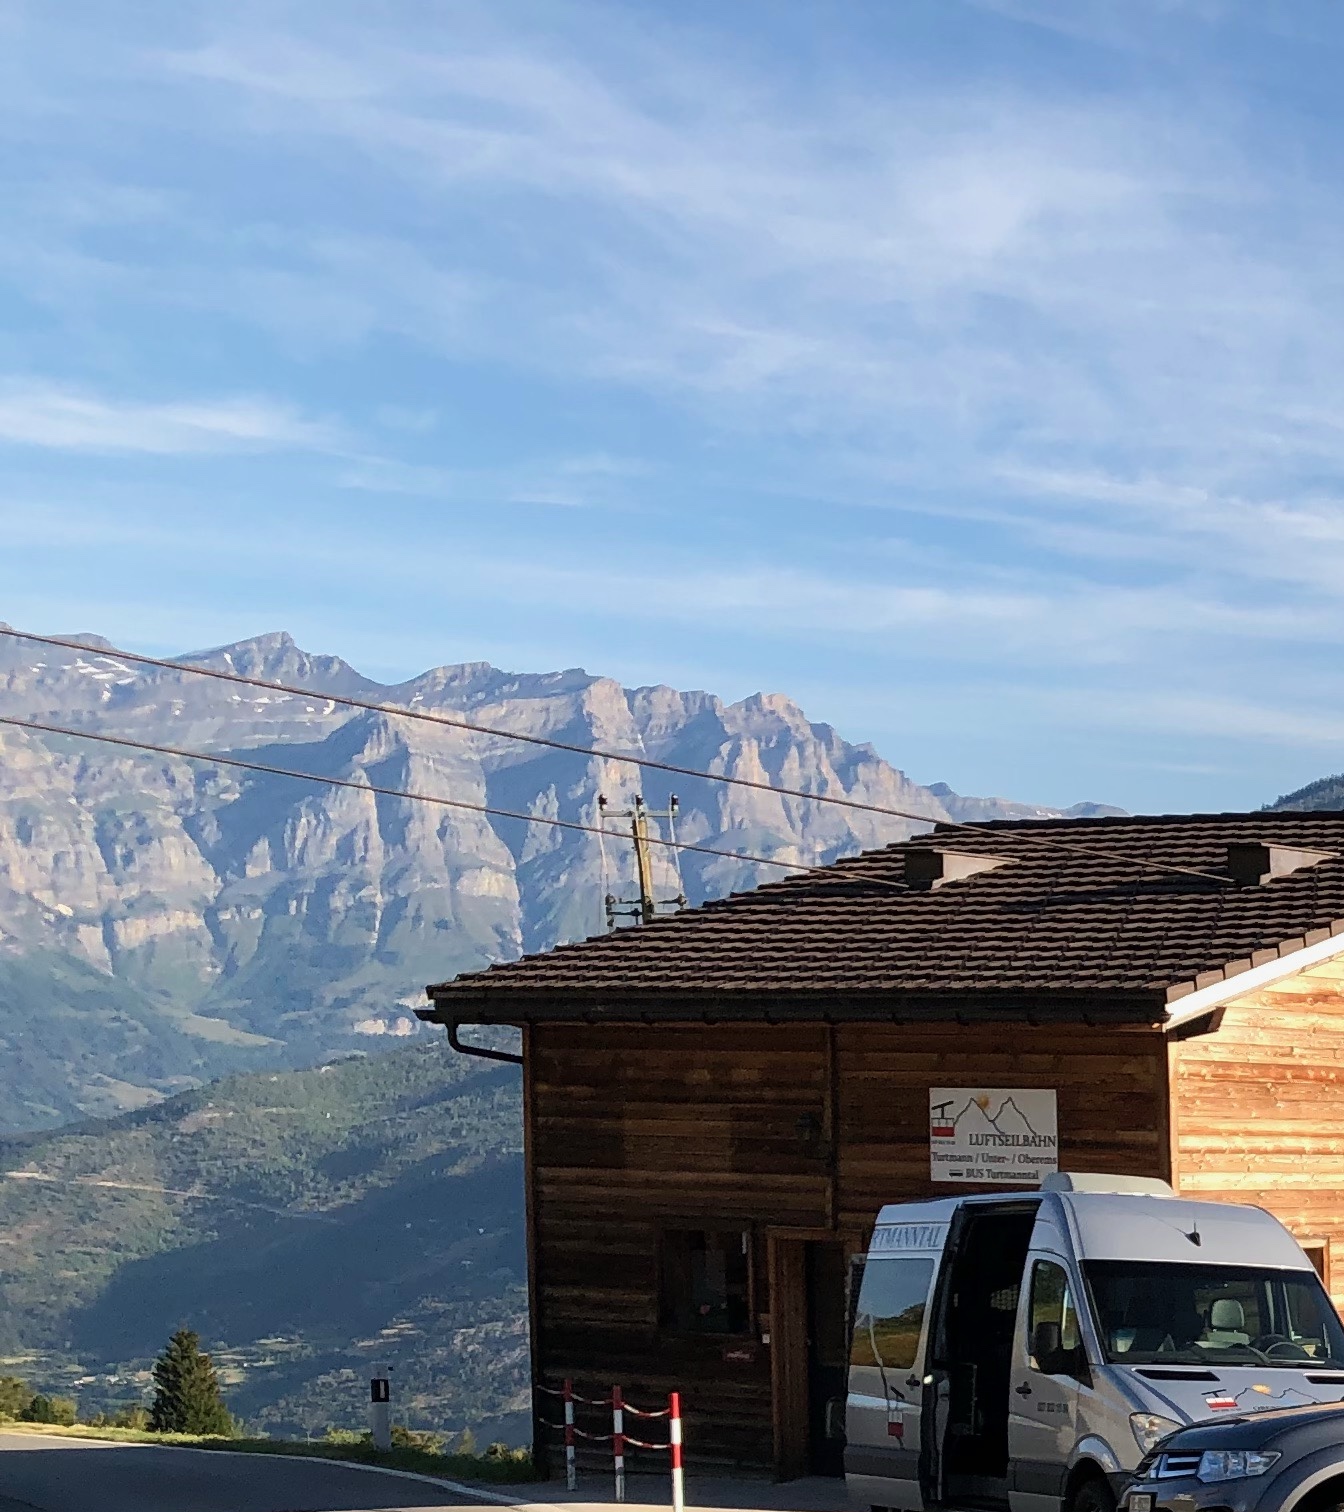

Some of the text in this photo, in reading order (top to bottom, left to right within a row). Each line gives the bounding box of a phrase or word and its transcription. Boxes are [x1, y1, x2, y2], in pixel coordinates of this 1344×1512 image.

[969, 1133, 1056, 1147] LUFTSEILBAHN
[931, 1151, 973, 1163] Turtmann
[981, 1152, 1010, 1164] Unter-
[1018, 1153, 1057, 1165] Oberems
[966, 1168, 1039, 1180] BUS Turtmanntal
